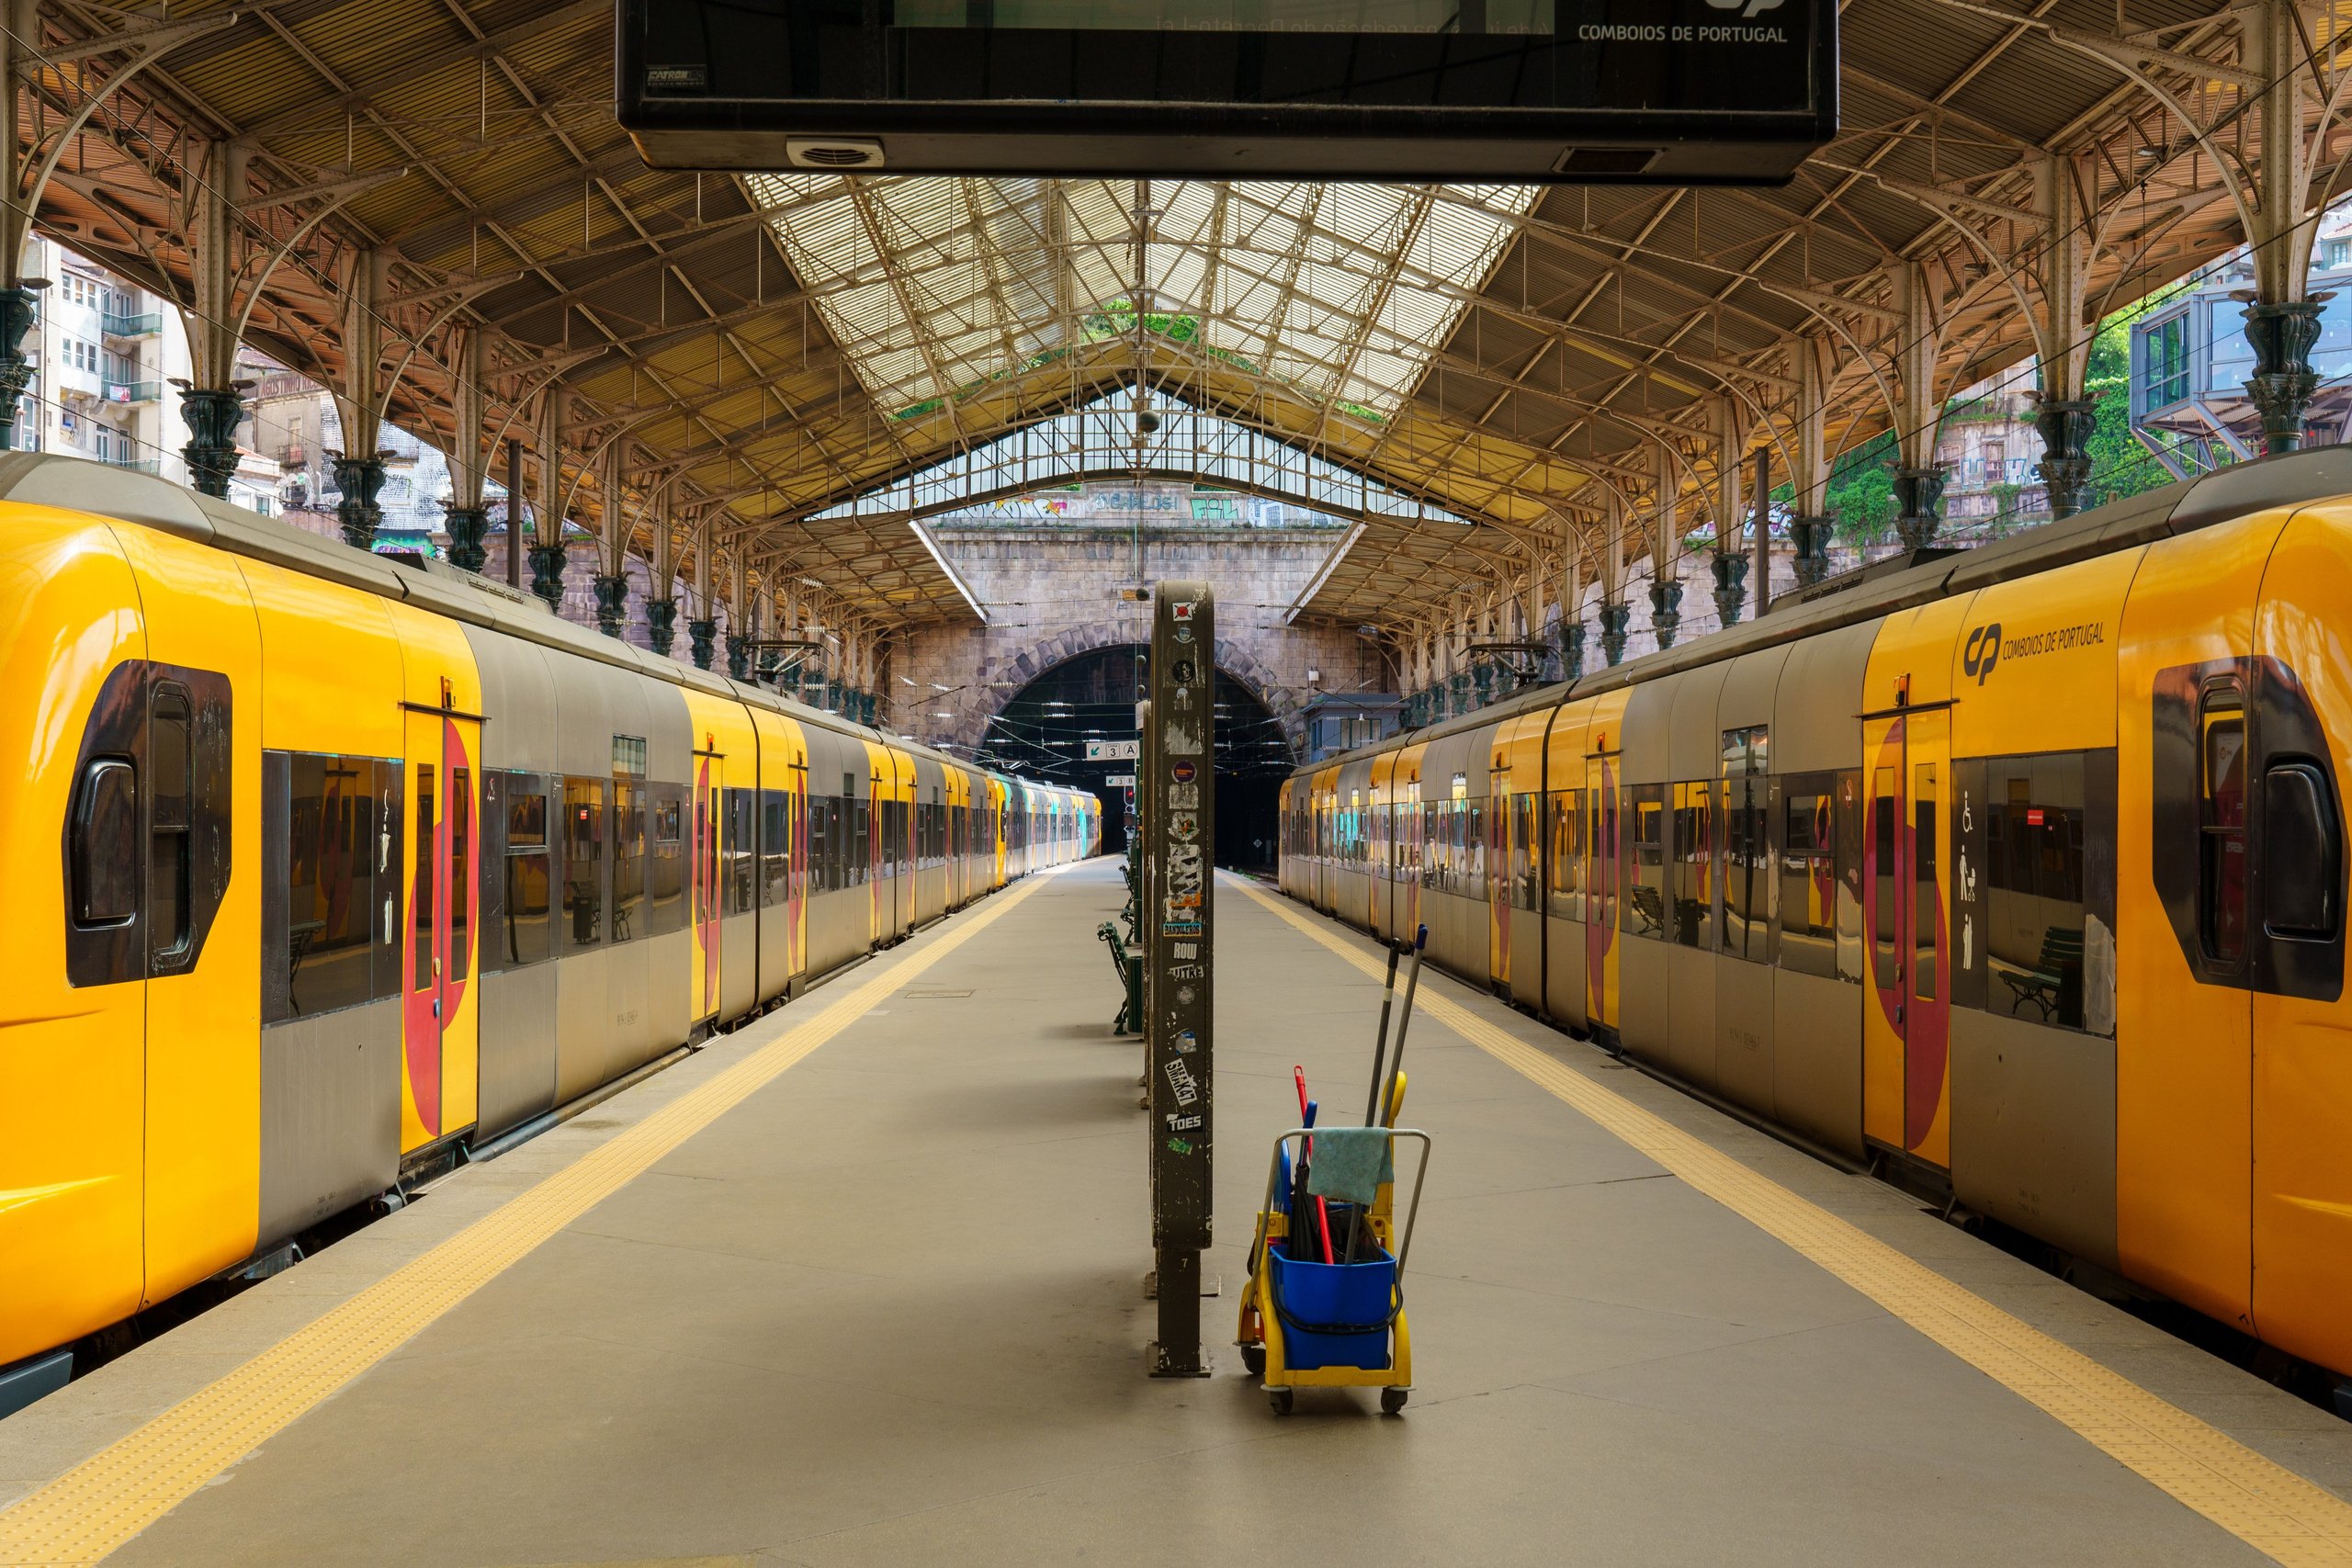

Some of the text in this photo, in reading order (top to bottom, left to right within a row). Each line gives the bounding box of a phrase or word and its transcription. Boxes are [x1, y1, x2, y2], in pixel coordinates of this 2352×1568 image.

[1578, 24, 1788, 43] COMBOIOS DE PORTUGAL
[261, 376, 300, 397] AGOSTINHO
[2003, 622, 2104, 660] COMBOIOS DE PORTUGAL
[1110, 745, 1135, 757] 3 A
[1164, 924, 1201, 935] BANDOLEROS
[1173, 942, 1198, 960] ROW
[1170, 1115, 1202, 1131] TOES
[1182, 1258, 1188, 1269] 7
